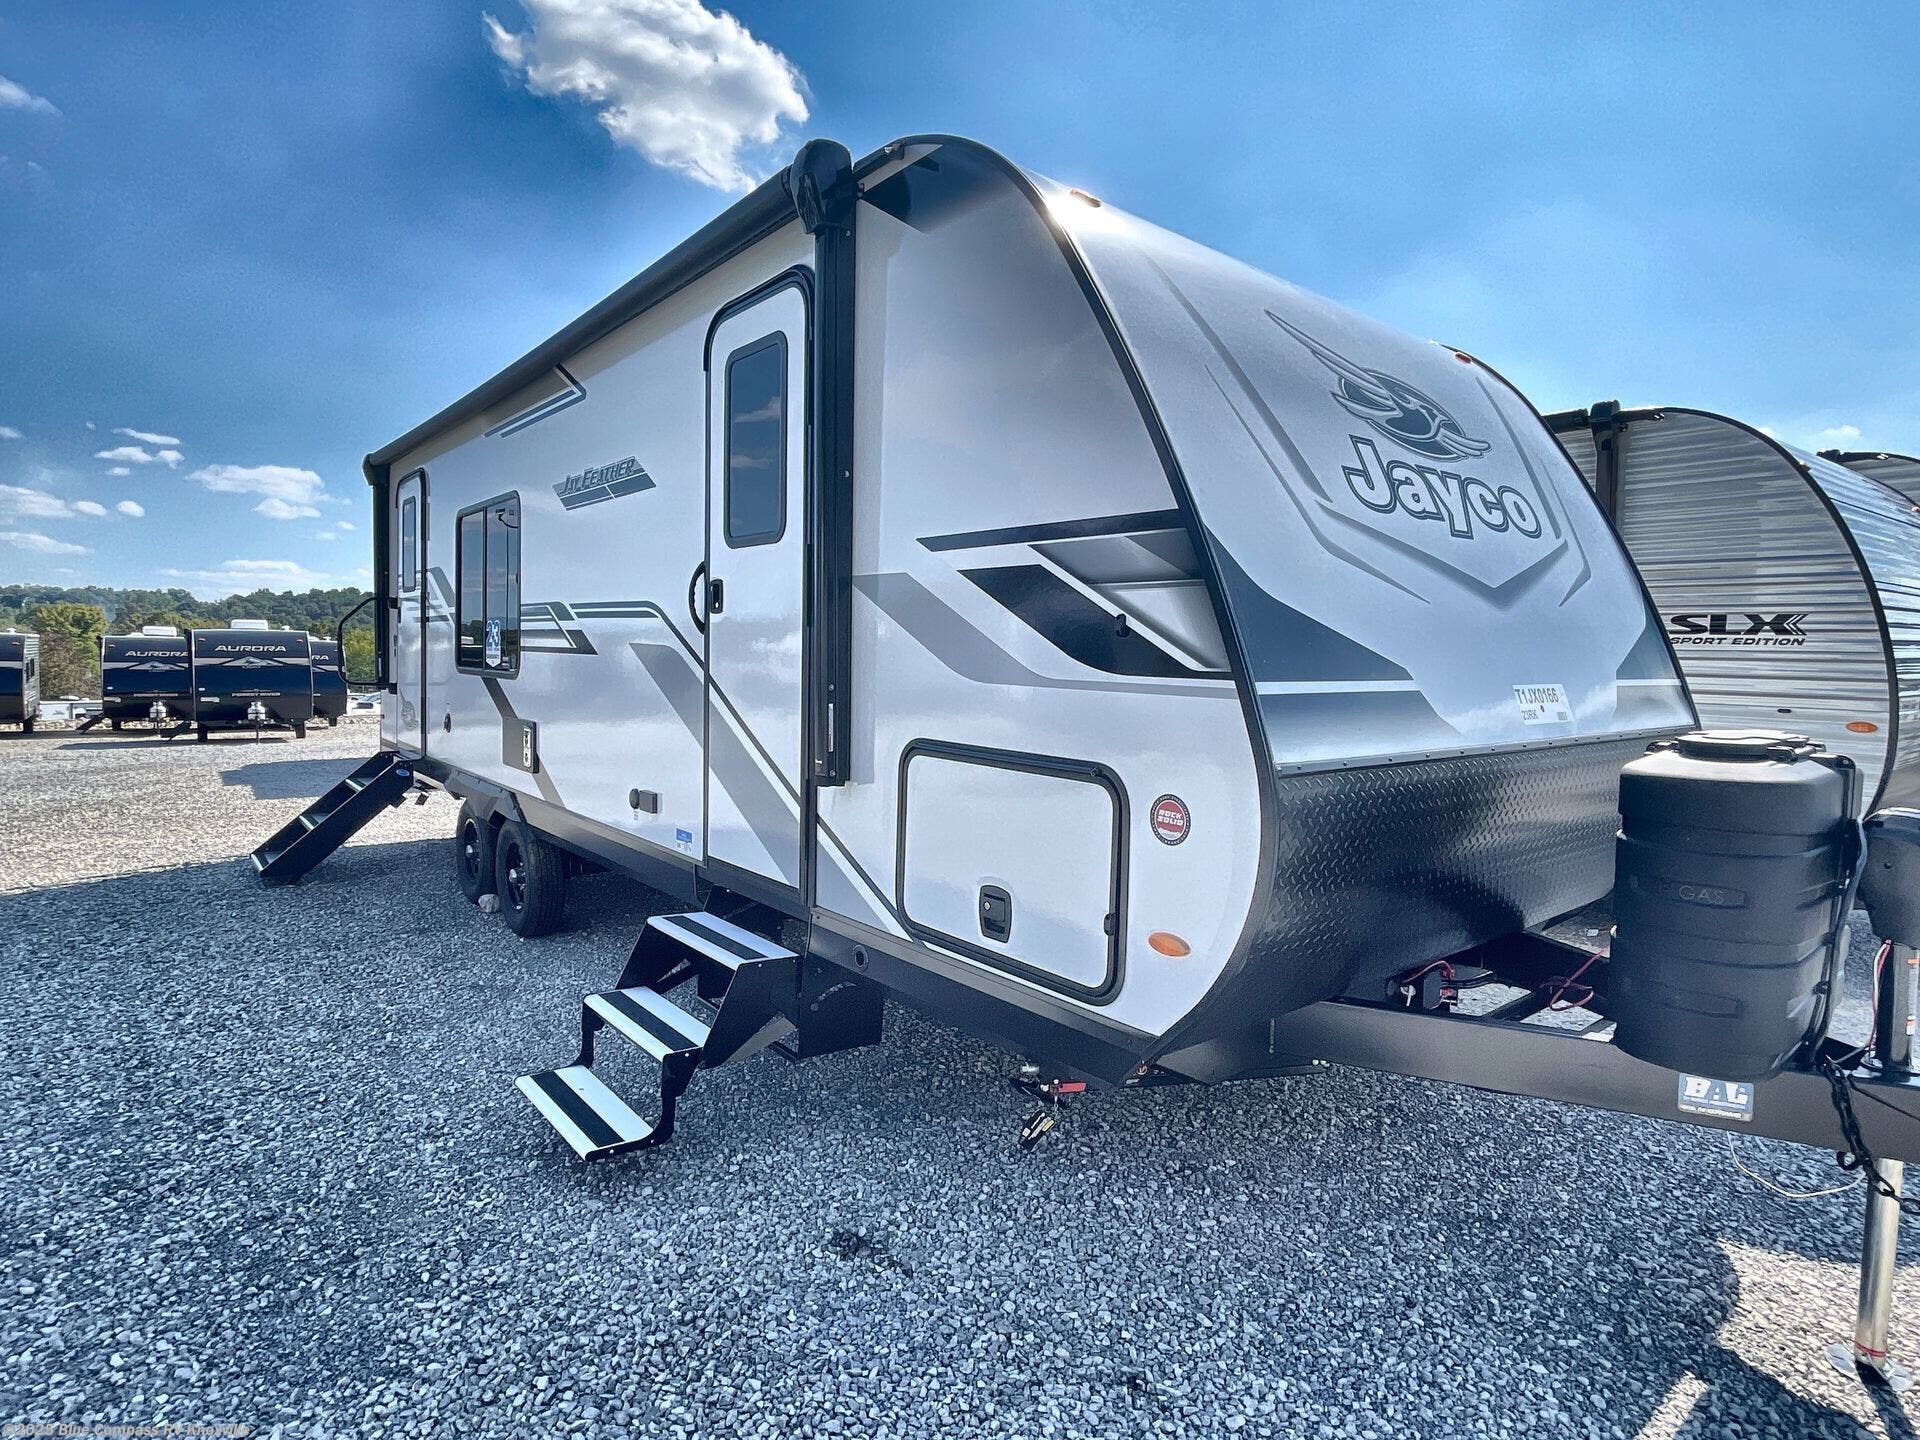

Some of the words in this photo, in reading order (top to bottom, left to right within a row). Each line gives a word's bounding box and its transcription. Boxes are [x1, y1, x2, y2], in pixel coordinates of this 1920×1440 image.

[581, 456, 636, 489] FEATHER
[1341, 434, 1542, 540] Jayco
[1669, 613, 1808, 635] SLX
[1670, 637, 1727, 645] SPORT
[1731, 637, 1806, 646] EDITION
[1514, 687, 1559, 704] T1JX0166
[1156, 815, 1184, 826] SOLID
[1158, 809, 1183, 819] ROCK
[1679, 885, 1728, 905] GAS
